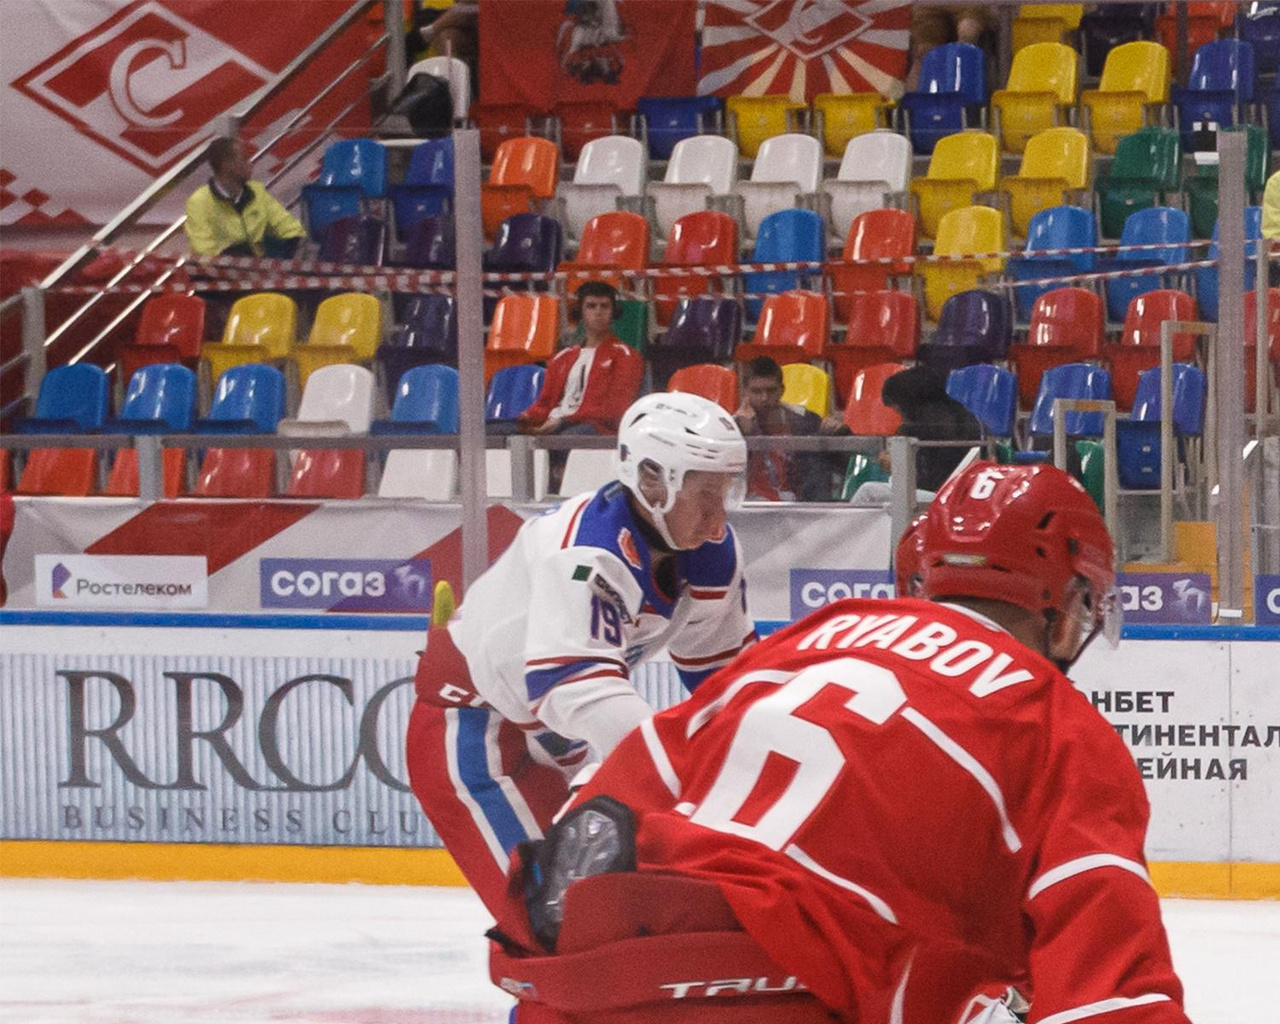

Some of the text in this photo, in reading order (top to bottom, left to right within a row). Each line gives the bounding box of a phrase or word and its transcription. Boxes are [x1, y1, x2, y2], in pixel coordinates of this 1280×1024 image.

[970, 470, 1005, 500] 6
[77, 579, 192, 597] Ростелеком
[802, 583, 894, 608] сога
[590, 594, 622, 648] 19
[797, 613, 1034, 698] RYABOV
[1083, 690, 1175, 713] НБЕТ
[690, 656, 908, 852] 6
[1137, 752, 1248, 780] ЕЙНАЯ
[63, 805, 422, 836] BUSINESS CLU
[659, 976, 806, 999] TRU
